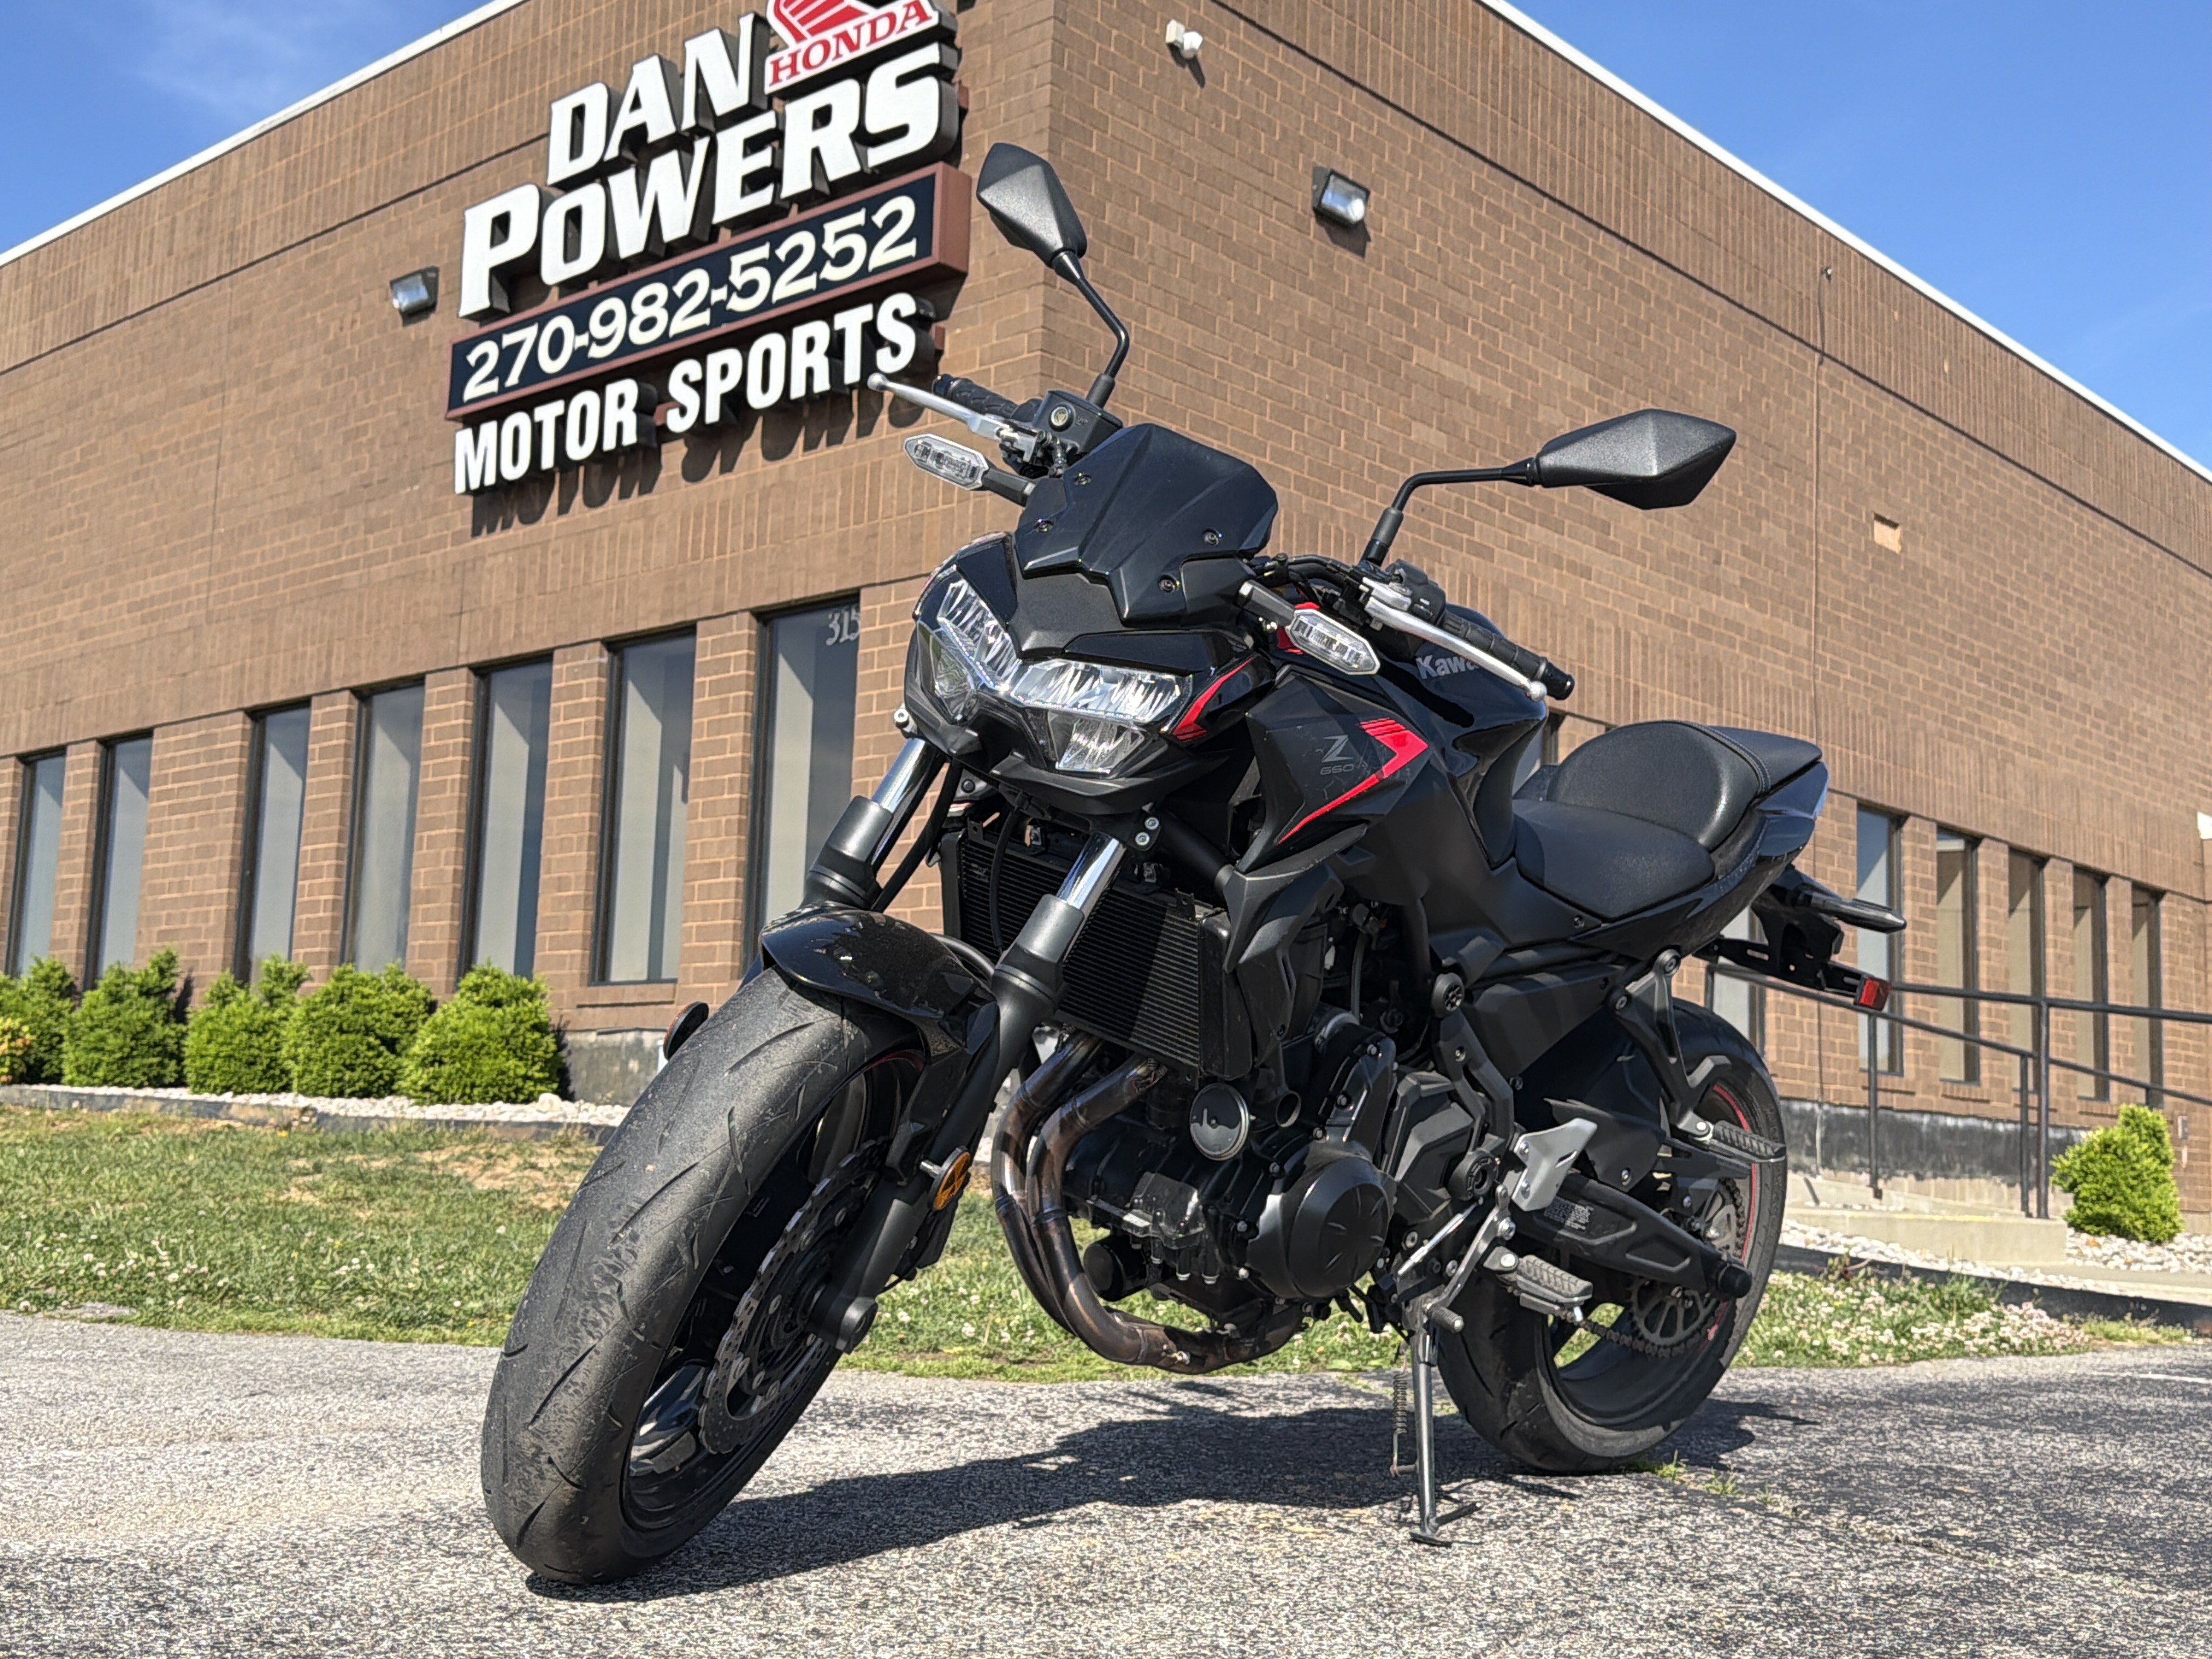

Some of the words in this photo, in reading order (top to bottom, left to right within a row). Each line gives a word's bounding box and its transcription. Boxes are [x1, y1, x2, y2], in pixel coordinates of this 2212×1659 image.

[548, 12, 760, 186] DAN
[769, 0, 932, 87] HONDA
[458, 42, 940, 318] POWERS
[462, 195, 918, 403] 270-982-5252
[454, 377, 638, 495] MOTOR
[665, 291, 917, 433] SPORTS
[826, 605, 861, 646] 315
[1319, 763, 1355, 775] 650
